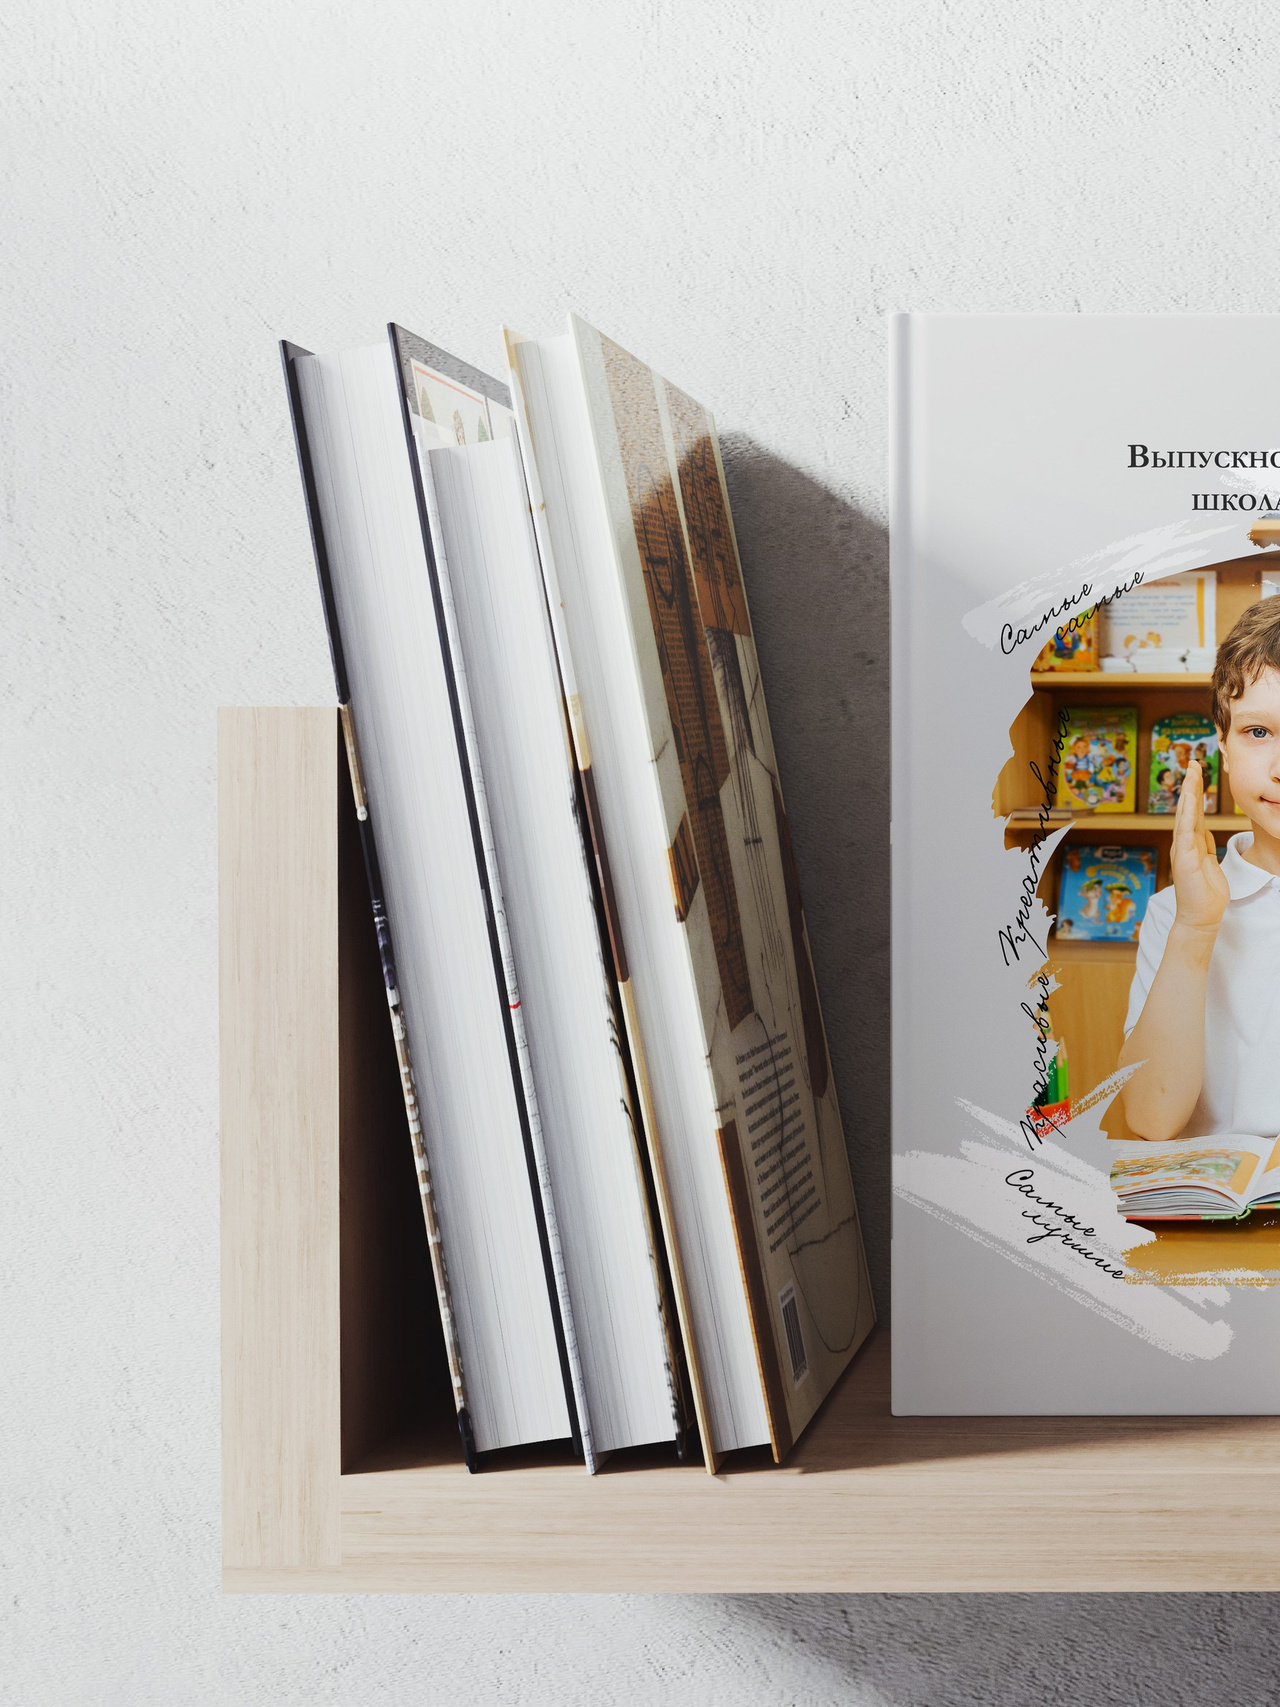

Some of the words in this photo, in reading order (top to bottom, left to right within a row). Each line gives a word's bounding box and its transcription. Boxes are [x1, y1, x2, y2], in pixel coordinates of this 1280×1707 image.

[1000, 583, 1094, 655] Самые
[1055, 571, 1145, 641] самые
[998, 705, 1071, 967] Креативные
[1019, 971, 1068, 1152] Красивые
[1004, 1168, 1097, 1237] Самые
[1021, 1210, 1126, 1280] лучшие
